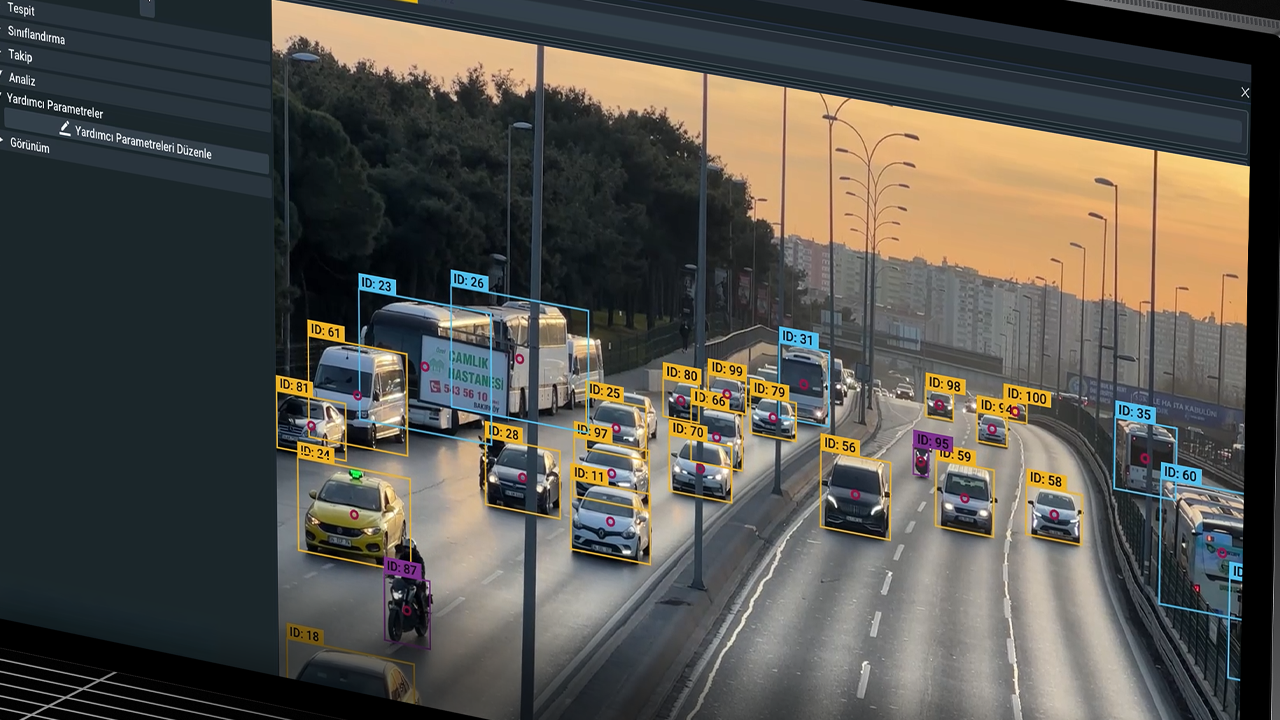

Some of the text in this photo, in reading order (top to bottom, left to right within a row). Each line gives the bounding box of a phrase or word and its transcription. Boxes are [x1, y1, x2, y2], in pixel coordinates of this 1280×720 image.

[8, 2, 34, 17] Tespit
[8, 26, 65, 44] Sınıflandırma
[9, 49, 32, 64] Takip
[9, 73, 35, 86] Analiz
[7, 92, 104, 119] Yardımcı Parametreler
[11, 138, 49, 153] Görünüm
[75, 125, 212, 160] Yardımcı Parametreleri Düzenle
[361, 277, 392, 292] ID: 23
[454, 274, 484, 289] ID: 26
[311, 324, 340, 338] ID: 61
[782, 330, 813, 346] ID: 31
[449, 351, 488, 370] ÇAMLIK
[667, 366, 698, 382] ID: 80
[712, 362, 743, 377] ID: 99
[280, 379, 308, 393] ID: 81
[448, 367, 503, 390] HASTANESİ
[929, 376, 961, 392] ID: 98
[463, 388, 474, 399] 56
[478, 391, 488, 402] 10
[590, 384, 620, 399] ID: 25
[754, 383, 785, 398] ID: 79
[1007, 387, 1047, 404] ID: 100
[694, 392, 726, 407] ID: 66
[981, 399, 1012, 415] ID: 94
[1119, 405, 1134, 418] ID:
[1136, 408, 1152, 421] 35
[489, 426, 519, 440] ID: 28
[577, 424, 608, 440] ID: 97
[673, 422, 704, 438] ID: 70
[824, 437, 856, 453] ID: 56
[917, 433, 949, 450] ID: 95
[301, 445, 330, 460] ID: 24
[939, 449, 971, 462] ID: 59
[574, 467, 604, 482] ID: 11
[1030, 471, 1062, 488] ID: 58
[1164, 467, 1197, 482] ID: 60
[387, 561, 417, 576] ID: 87
[289, 627, 320, 642] ID: 18
